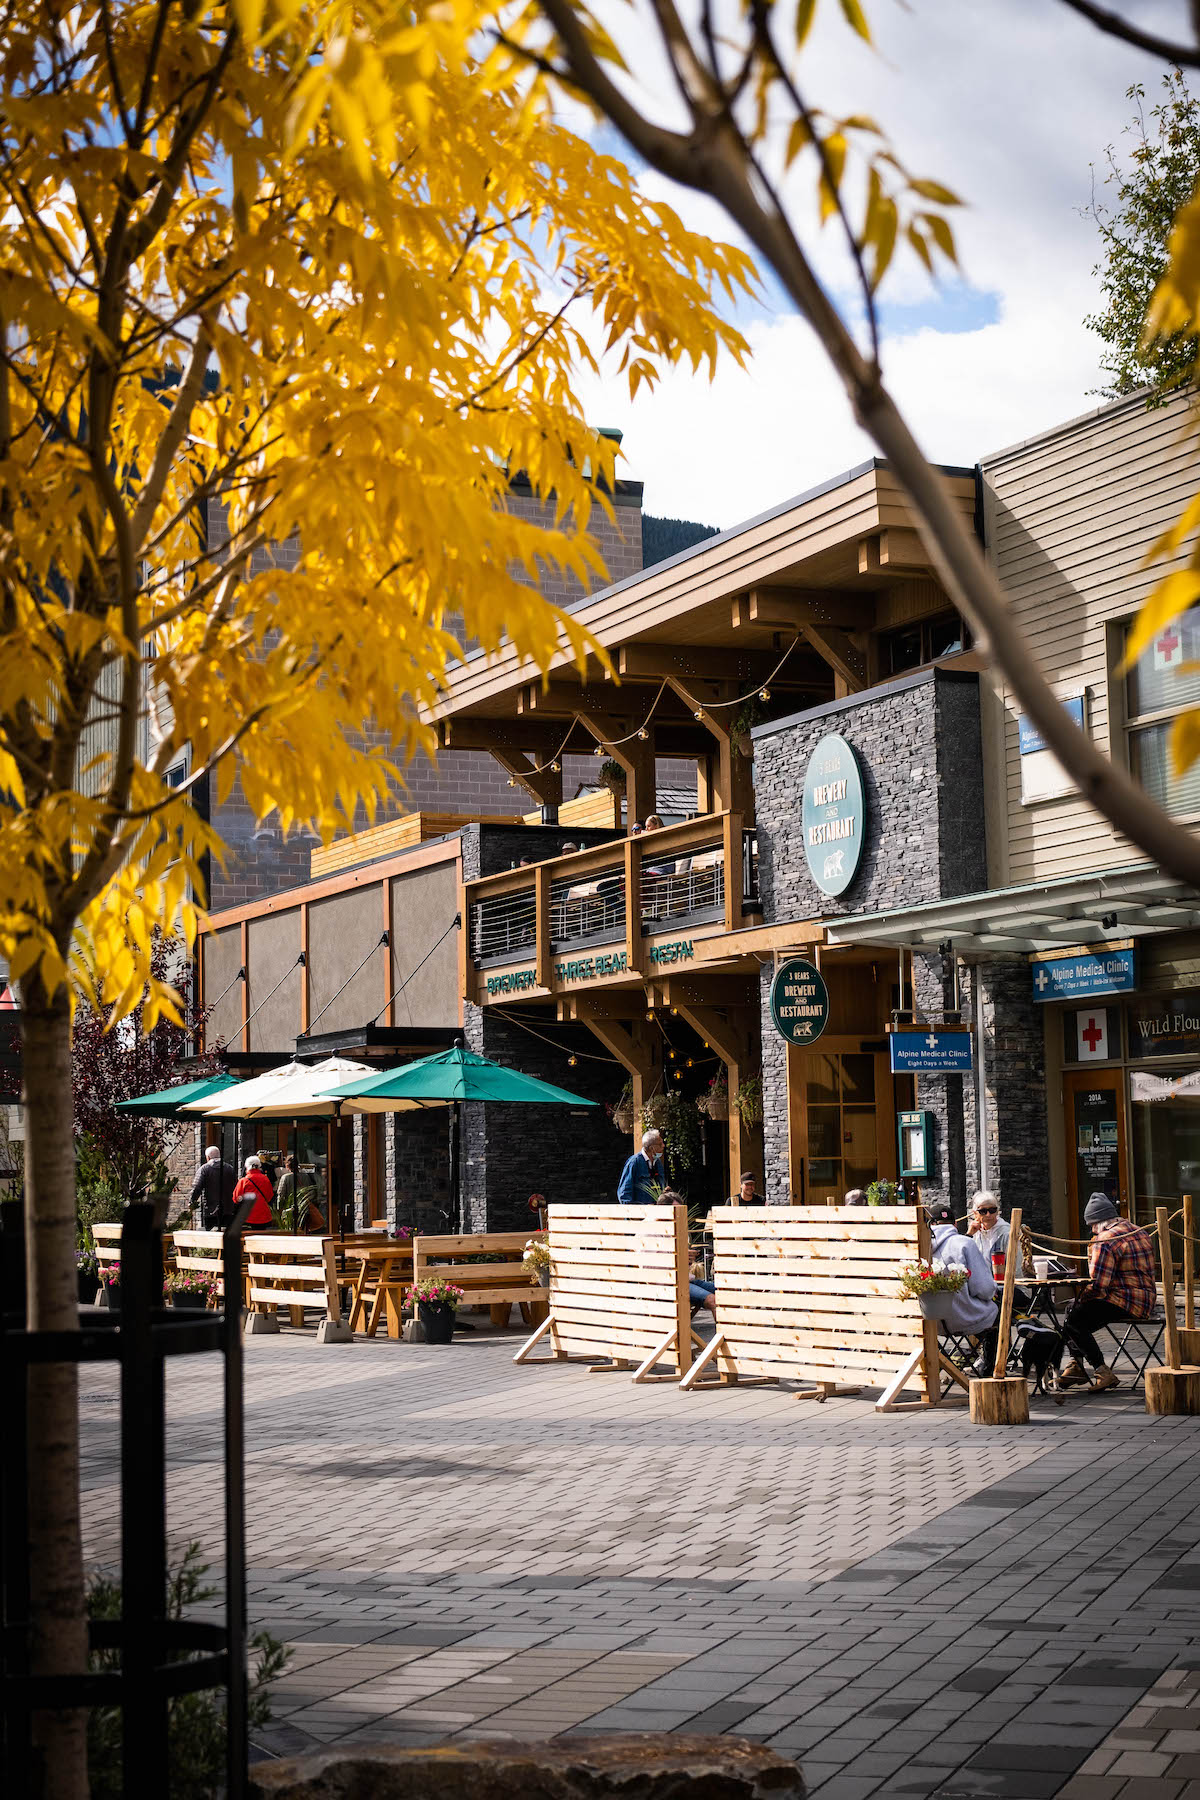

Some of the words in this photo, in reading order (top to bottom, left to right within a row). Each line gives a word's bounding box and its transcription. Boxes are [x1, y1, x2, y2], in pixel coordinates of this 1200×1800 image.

[813, 778, 848, 807] BREWERY
[826, 808, 838, 818] AND
[808, 816, 856, 846] RESTAURANT
[487, 969, 537, 993] BREWERY
[555, 958, 592, 981] THREE
[789, 972, 793, 981] 3
[794, 971, 810, 980] BEARS
[1051, 967, 1074, 982] Alpine
[1075, 962, 1105, 977] Medical
[1106, 959, 1129, 973] Clinic
[784, 984, 816, 997] BREWERY
[780, 1004, 824, 1018] RESTAURANT
[897, 1050, 919, 1059] Alpine
[920, 1050, 947, 1058] Medical
[948, 1050, 968, 1058] Clinic
[1088, 1094, 1102, 1102] 201A
